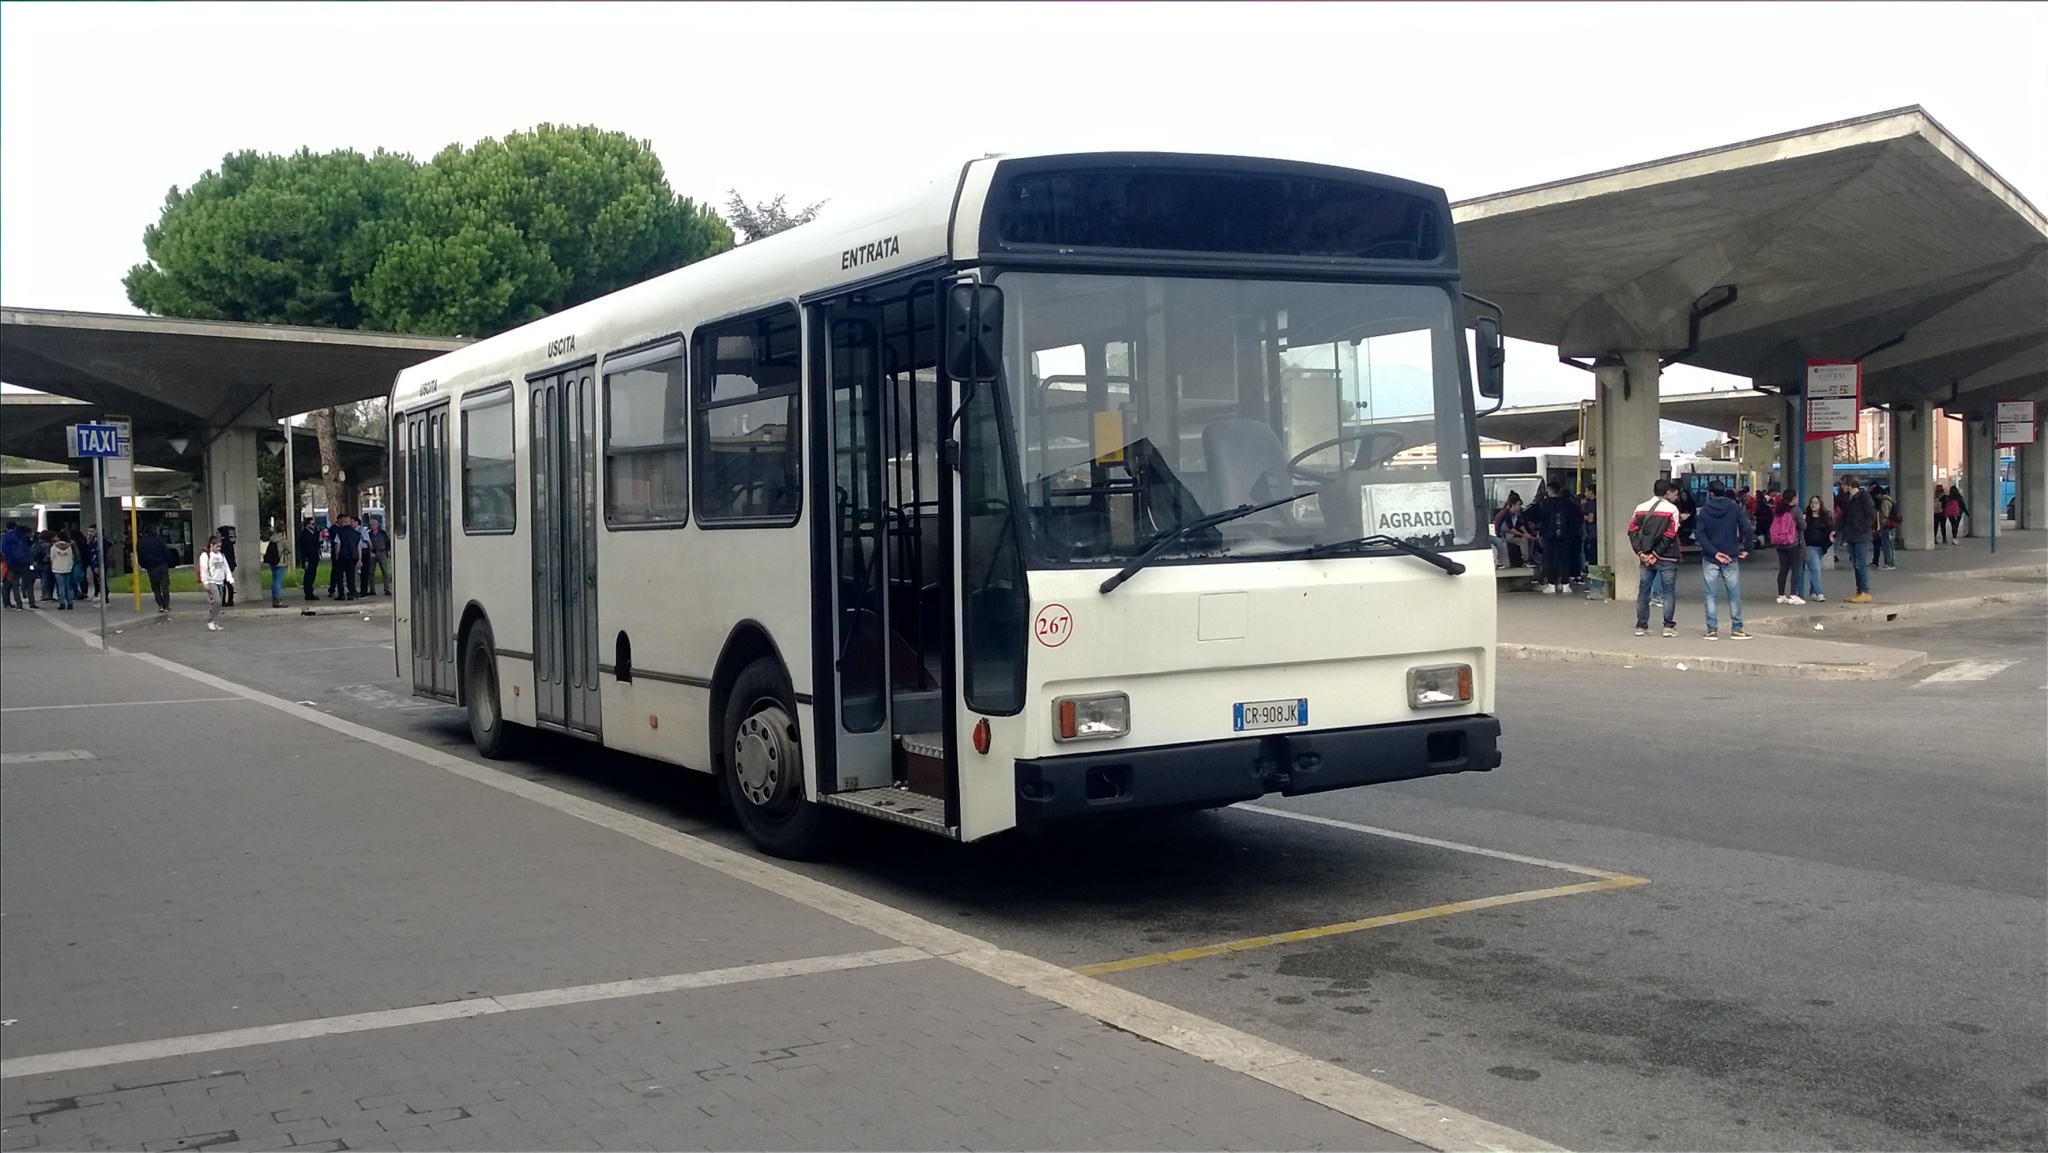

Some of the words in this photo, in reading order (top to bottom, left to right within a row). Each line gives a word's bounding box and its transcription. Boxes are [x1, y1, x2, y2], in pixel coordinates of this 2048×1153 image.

[841, 235, 900, 271] ENTRATA
[547, 334, 576, 359] USCITA
[419, 379, 439, 397] USCITA
[79, 430, 117, 453] TAXI
[1379, 510, 1453, 530] AGRARIO
[1038, 616, 1069, 635] 267
